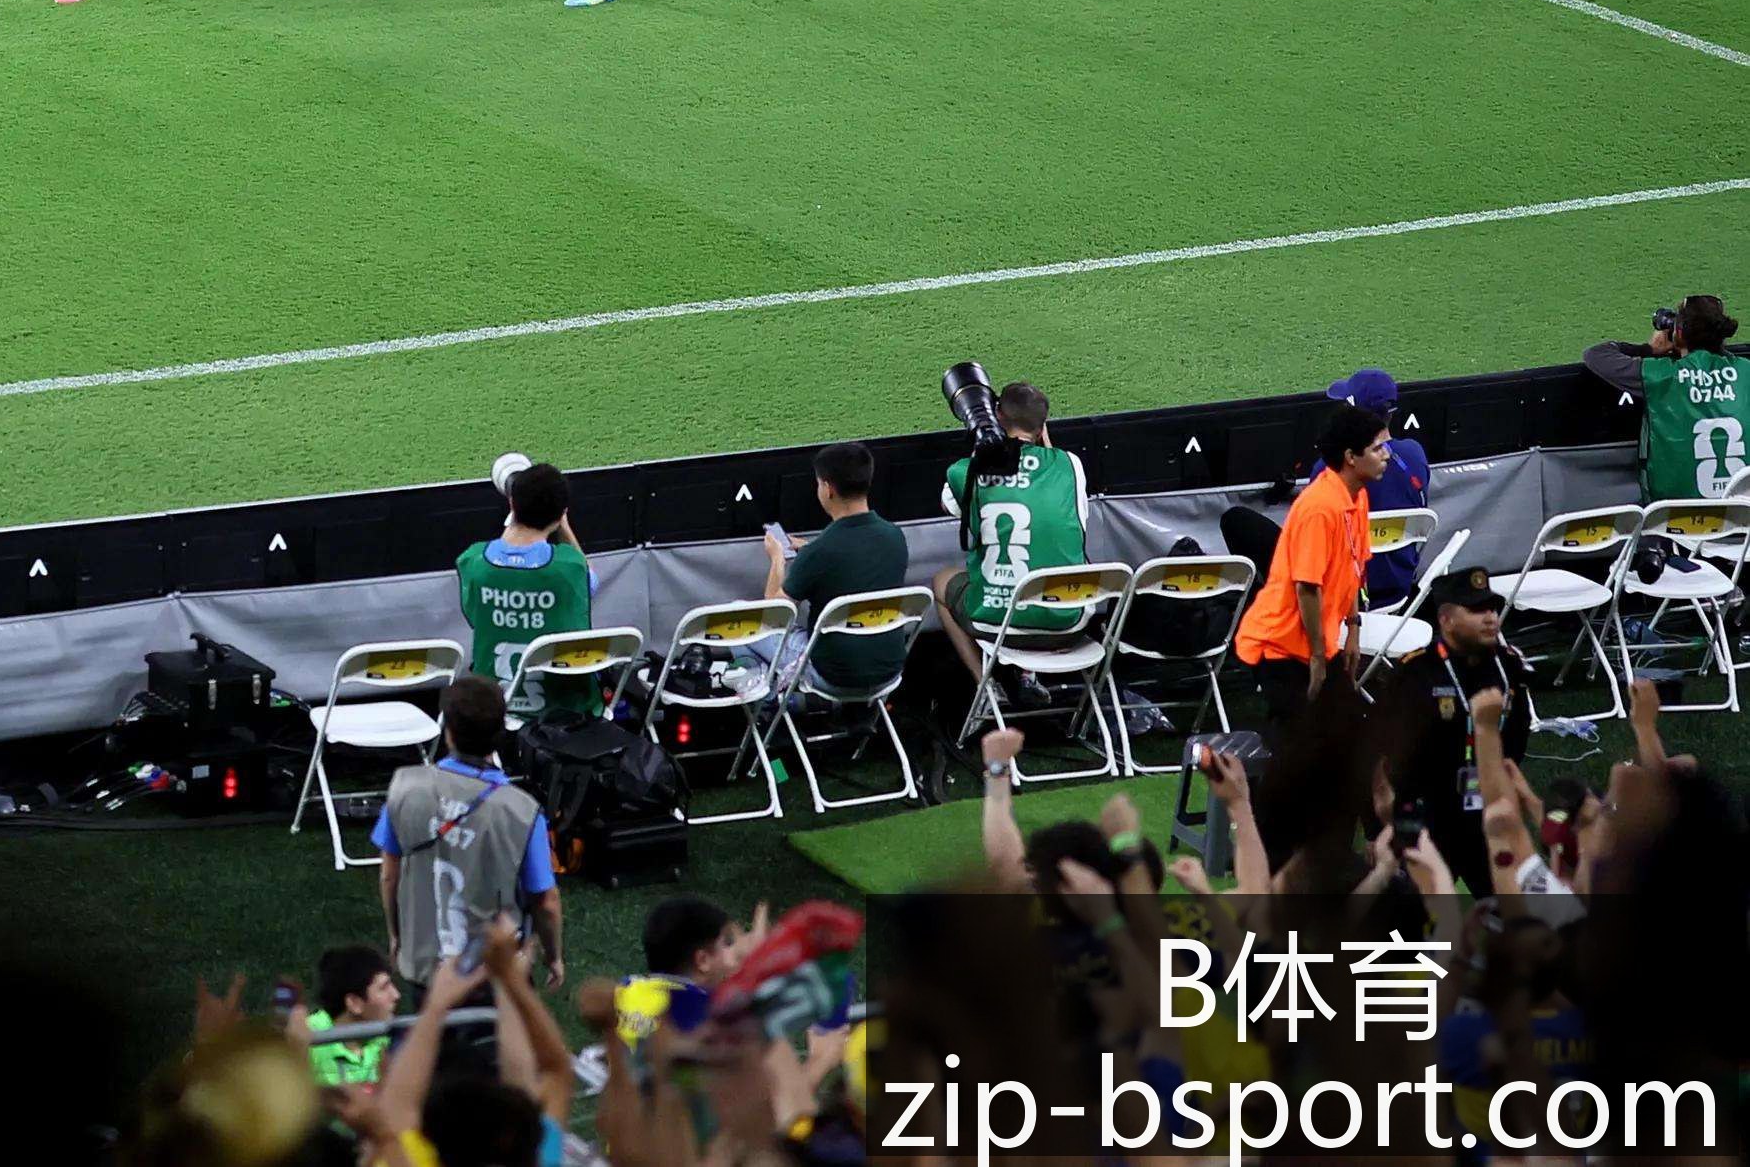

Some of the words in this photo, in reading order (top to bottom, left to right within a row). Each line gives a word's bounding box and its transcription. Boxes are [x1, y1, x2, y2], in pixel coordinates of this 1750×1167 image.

[1678, 366, 1738, 386] PHOTO
[1689, 384, 1736, 404] 0744
[1712, 480, 1732, 491] FIF
[1373, 527, 1387, 538] 16
[994, 569, 1015, 578] FIFA
[481, 586, 556, 609] PHOTO
[492, 611, 545, 629] 0618
